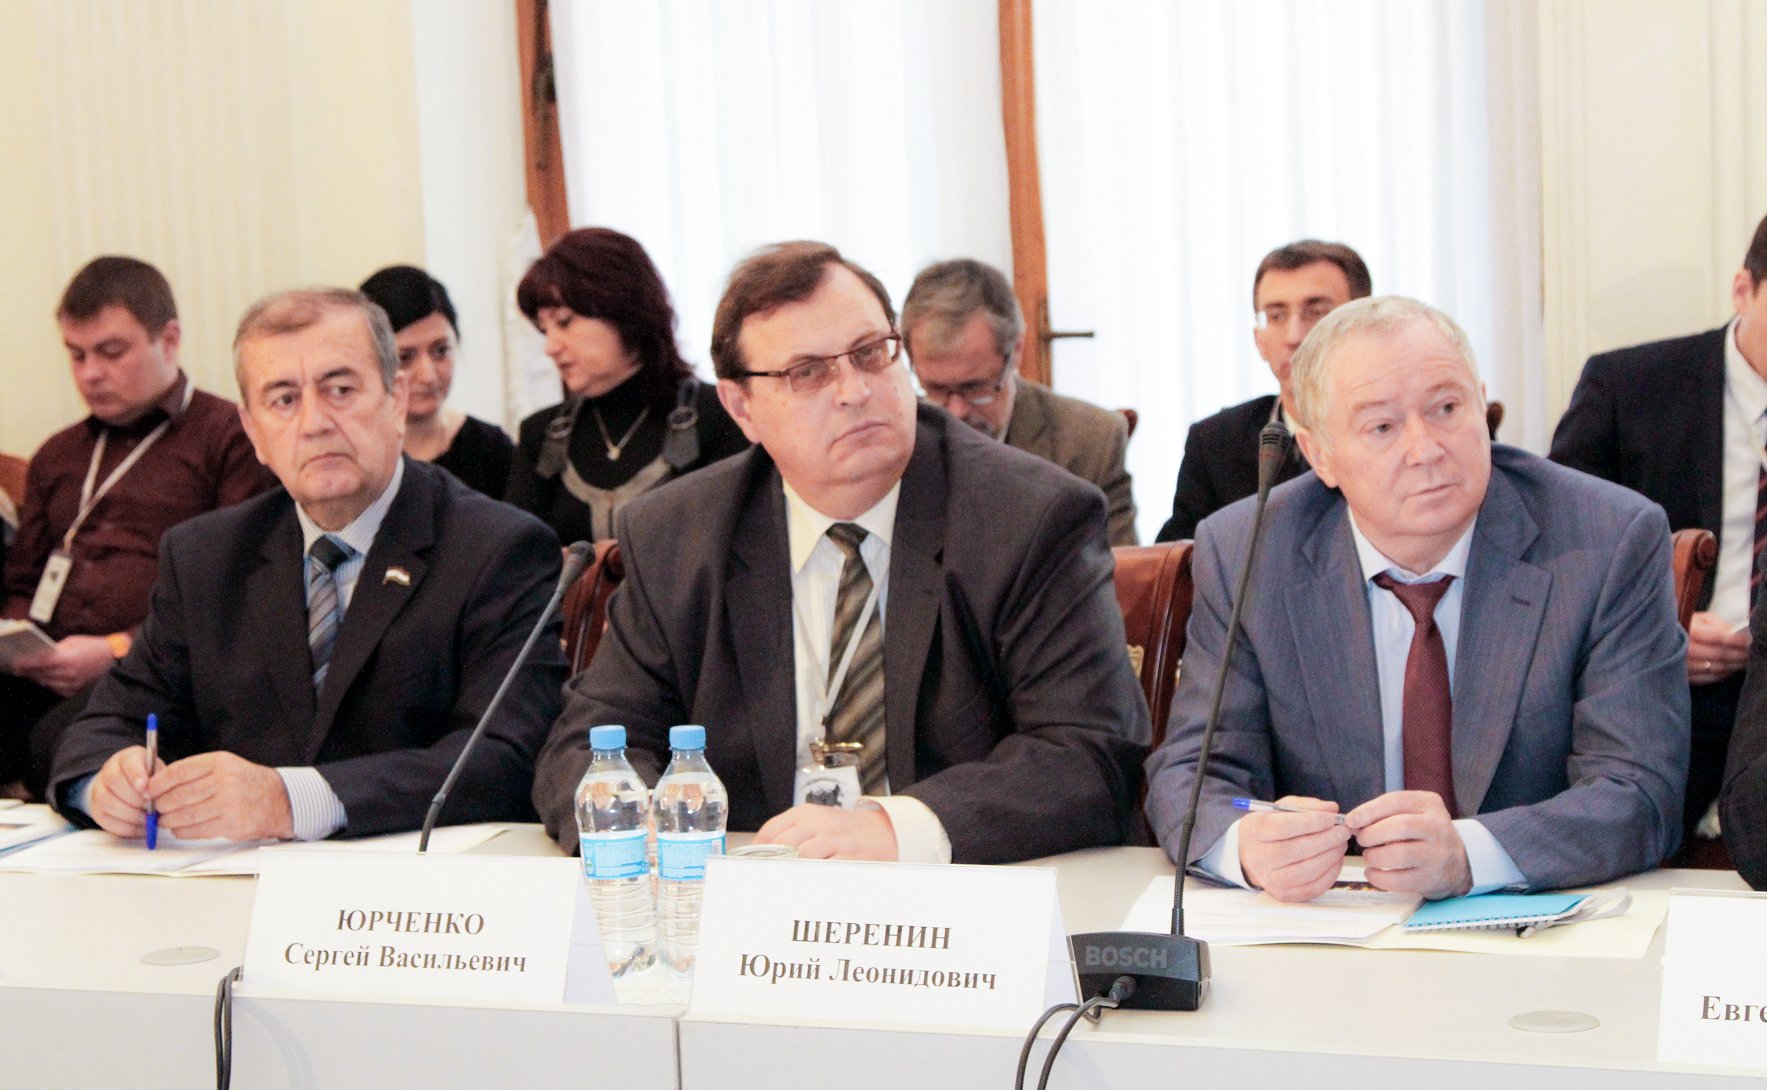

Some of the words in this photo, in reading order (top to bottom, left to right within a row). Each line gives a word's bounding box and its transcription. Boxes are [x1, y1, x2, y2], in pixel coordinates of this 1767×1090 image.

[337, 909, 485, 935] ЮРЧЕНКО
[791, 919, 952, 949] ШЕРЕНИН
[284, 942, 369, 970] Сергей
[379, 945, 527, 972] Васильевич
[739, 953, 820, 984] Юрий
[828, 957, 997, 990] Леонидович
[1085, 945, 1168, 968] BOSCH
